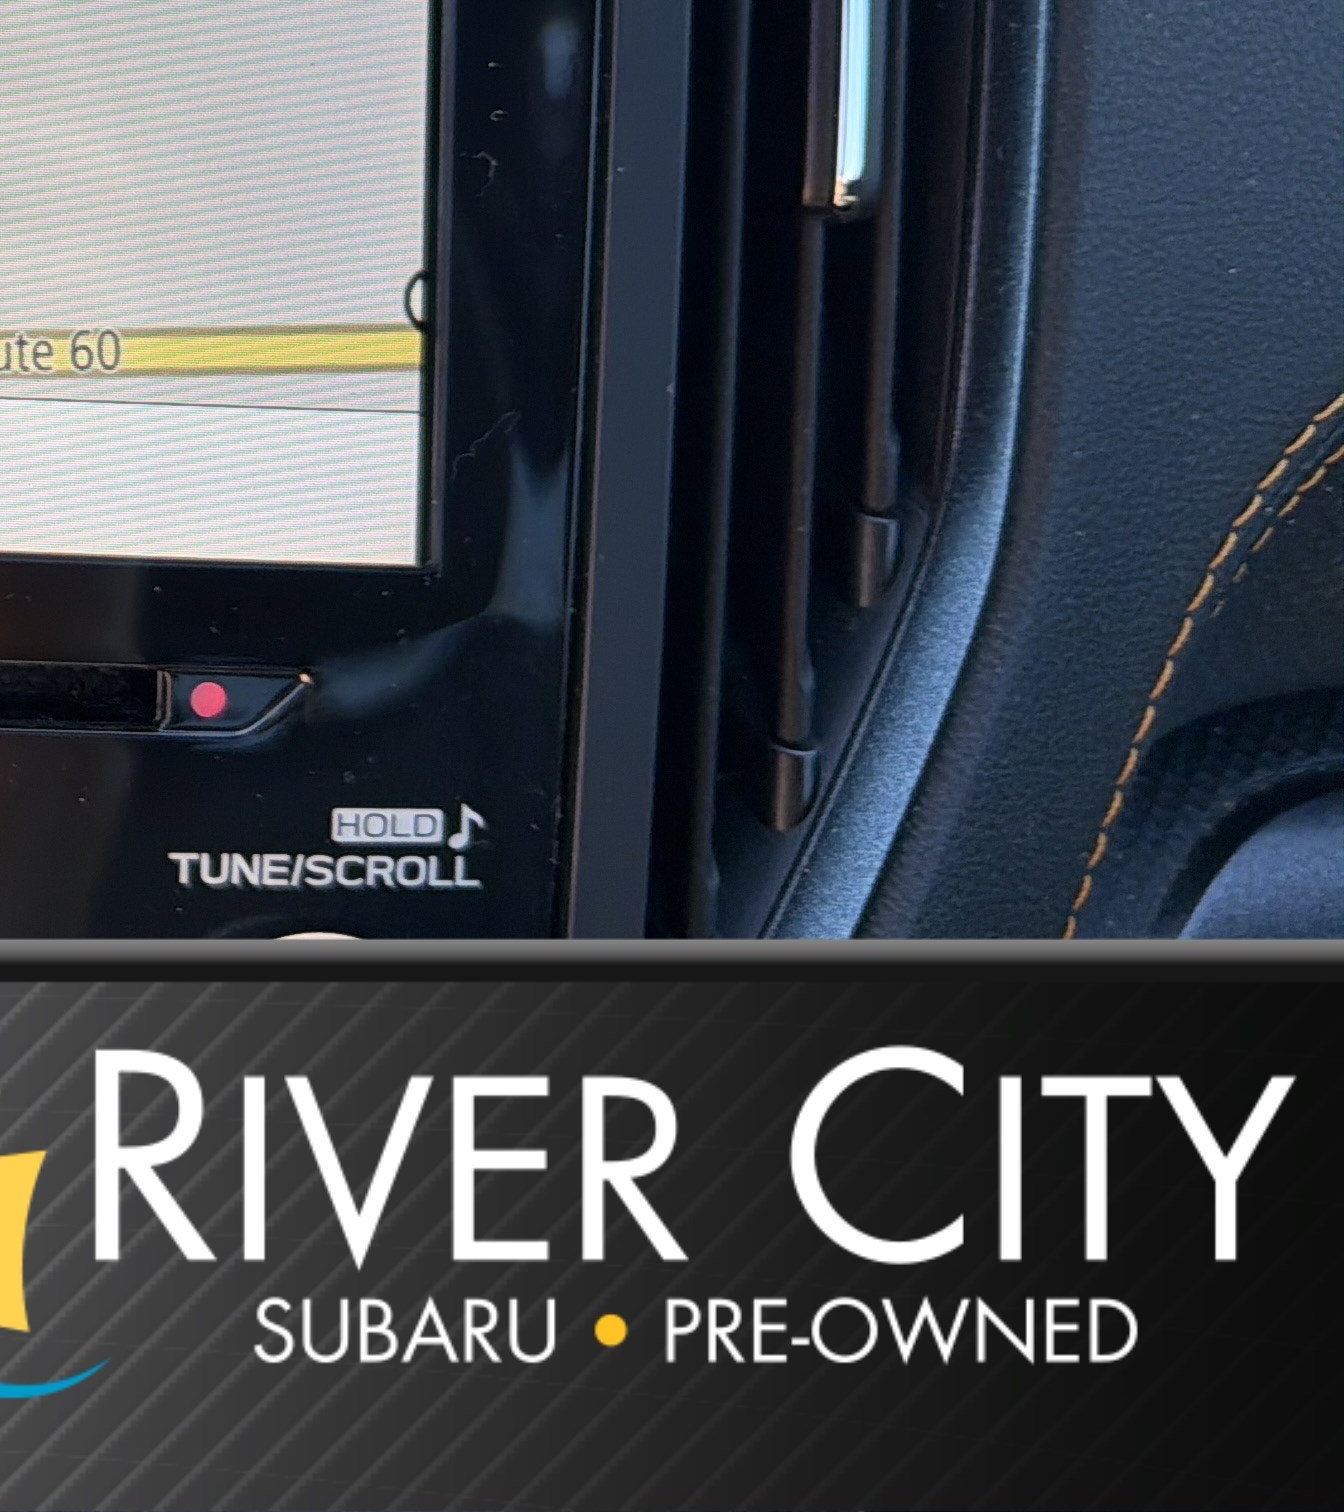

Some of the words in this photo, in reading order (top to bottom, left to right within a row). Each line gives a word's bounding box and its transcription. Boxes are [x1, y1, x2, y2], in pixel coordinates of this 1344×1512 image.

[71, 328, 120, 371] 60
[334, 810, 441, 841] HOLD
[167, 851, 482, 890] TUNE/SCROLL
